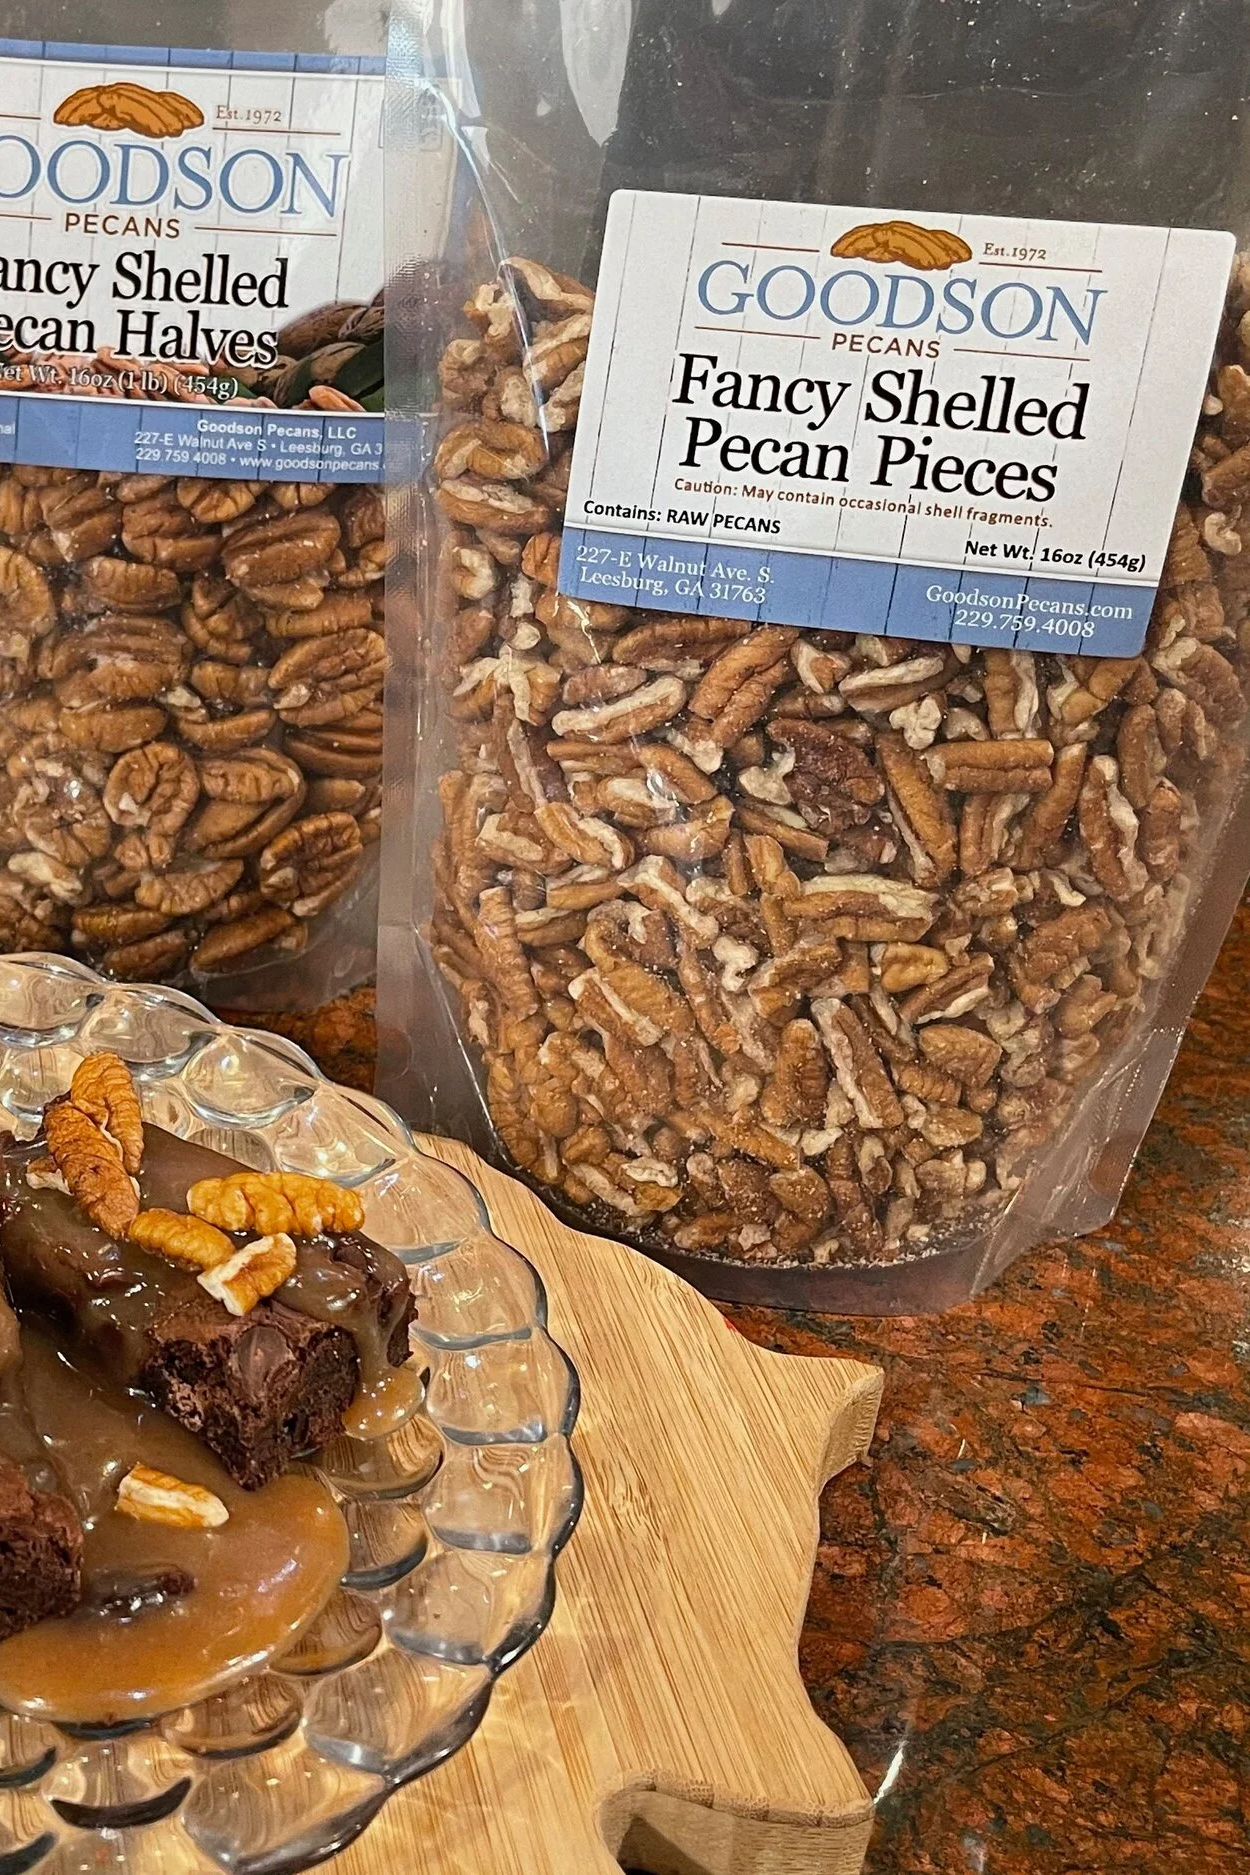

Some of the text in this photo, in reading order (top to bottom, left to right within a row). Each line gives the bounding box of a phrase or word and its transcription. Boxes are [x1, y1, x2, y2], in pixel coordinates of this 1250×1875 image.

[65, 211, 181, 239] PECANS
[983, 242, 1047, 262] Est.1972
[112, 249, 290, 310] Shelled
[697, 260, 1108, 346] GOODSON
[114, 308, 278, 368] Halves
[832, 333, 940, 359] PECANS
[29, 364, 62, 385] Wt.
[69, 370, 114, 390] 16oz
[140, 371, 168, 394] lb)
[173, 375, 239, 400] (454g)
[672, 353, 1090, 440] Fancy Shelled
[134, 431, 174, 447] 227-E
[178, 434, 225, 450] Walnut
[230, 439, 253, 451] Ave
[257, 439, 267, 452] S
[280, 440, 346, 458] Leesburg,
[351, 442, 373, 456] GA
[197, 419, 357, 440] Goodson Pecans, LLC
[678, 417, 1058, 502] Pecan Pieces
[583, 500, 781, 534] Contains: RAW PECANS
[674, 478, 1053, 528] Caution: May contain occasional shell fragments.
[576, 545, 775, 584] 227-E Walnut Ave. S.
[965, 540, 1146, 573] Net Wt. 16oz (454g)
[580, 566, 767, 605] Leesburg, GA 31763
[925, 584, 1134, 620] GoodsonPecans.com
[954, 609, 1096, 638] 229.759.4008
